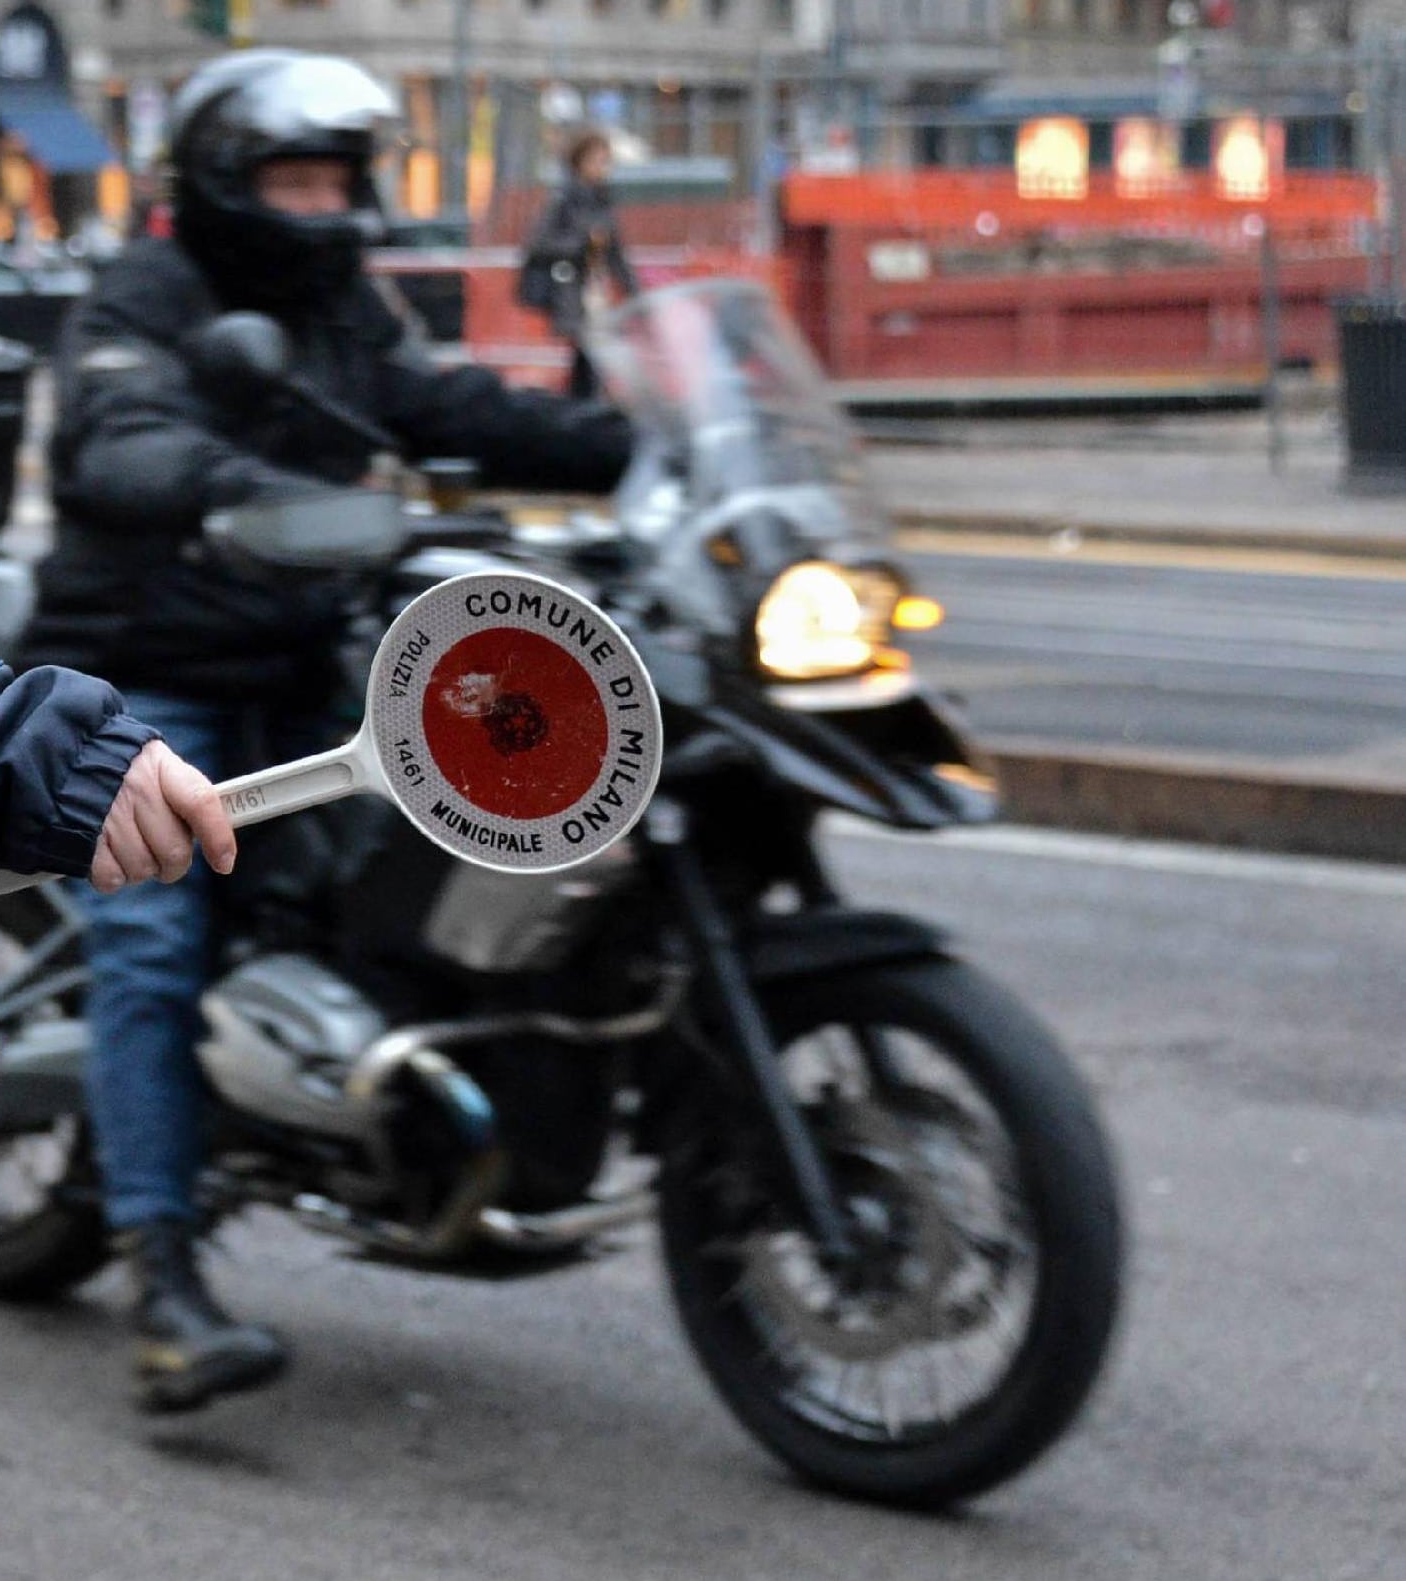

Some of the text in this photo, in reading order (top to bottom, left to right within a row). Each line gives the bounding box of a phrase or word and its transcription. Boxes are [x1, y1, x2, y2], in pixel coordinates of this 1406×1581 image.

[389, 630, 431, 699] POLIZIA
[465, 590, 643, 844] COMUNE DI MILANO
[394, 738, 425, 787] 1461
[225, 786, 266, 814] 1461
[430, 799, 543, 853] MUNICIPALE
